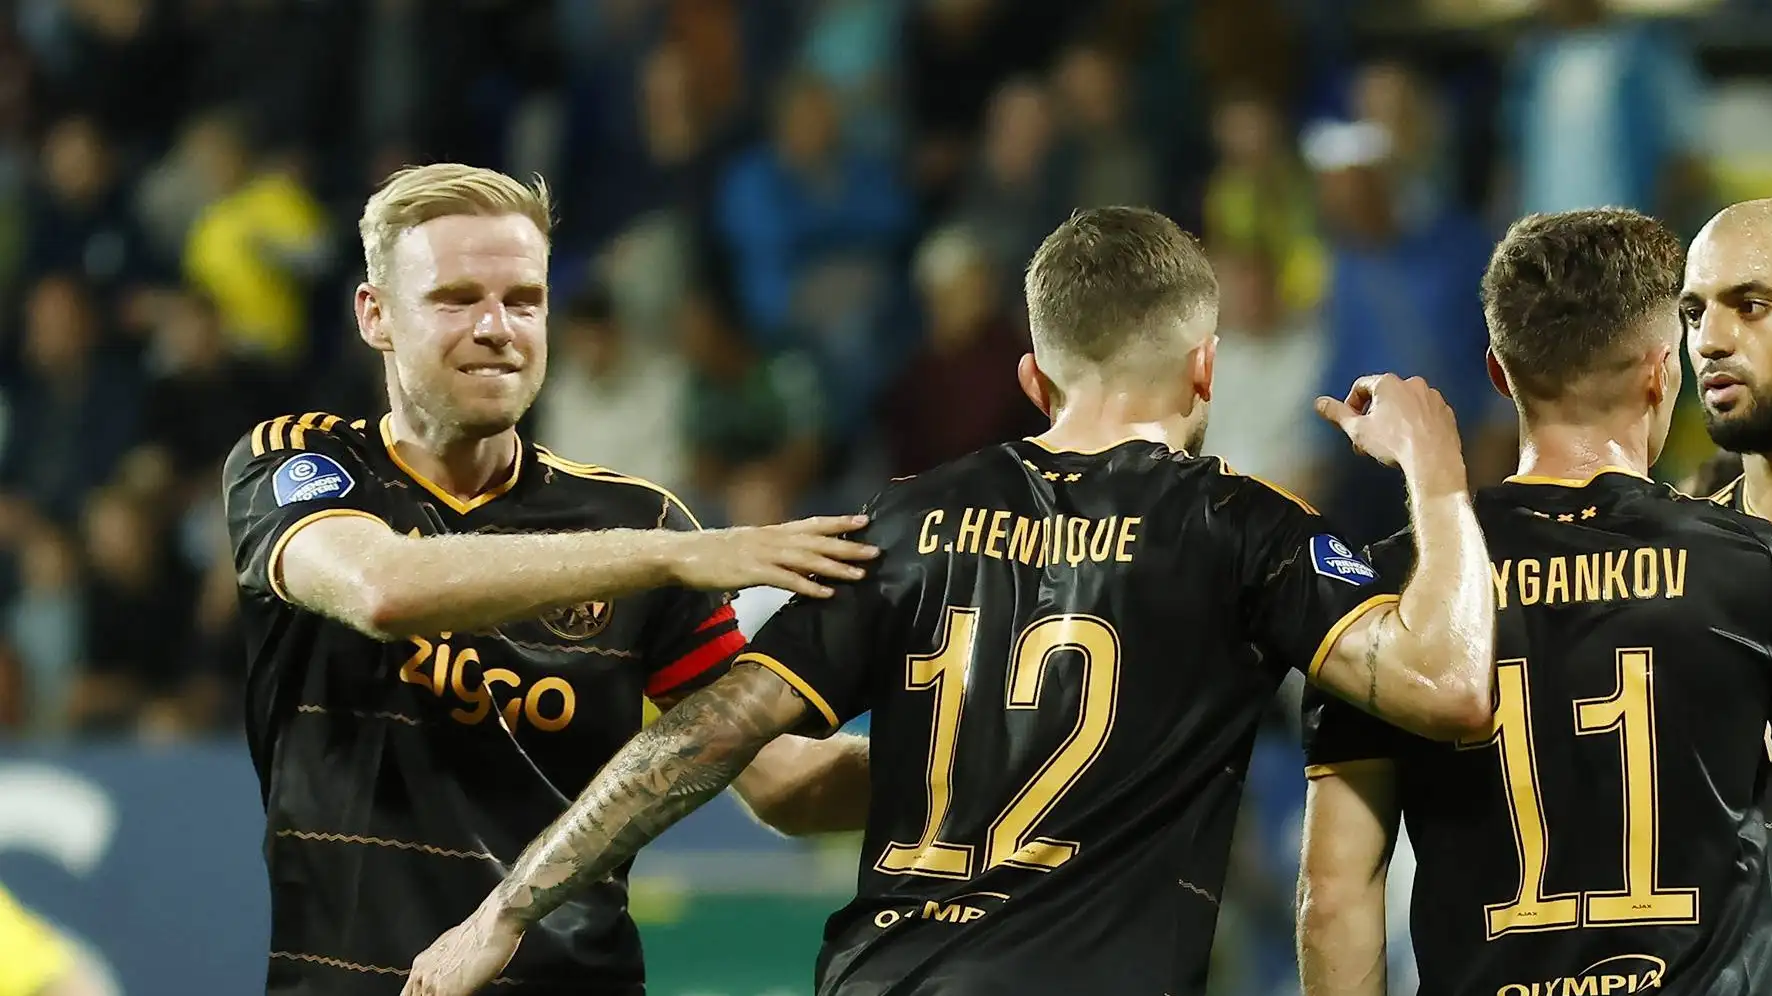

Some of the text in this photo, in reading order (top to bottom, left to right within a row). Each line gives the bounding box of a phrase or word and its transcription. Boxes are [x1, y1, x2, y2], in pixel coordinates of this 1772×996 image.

[1490, 548, 1688, 611] YGANKOV
[400, 629, 576, 737] ziggo
[875, 606, 1122, 880] 12
[1456, 647, 1700, 942] 11
